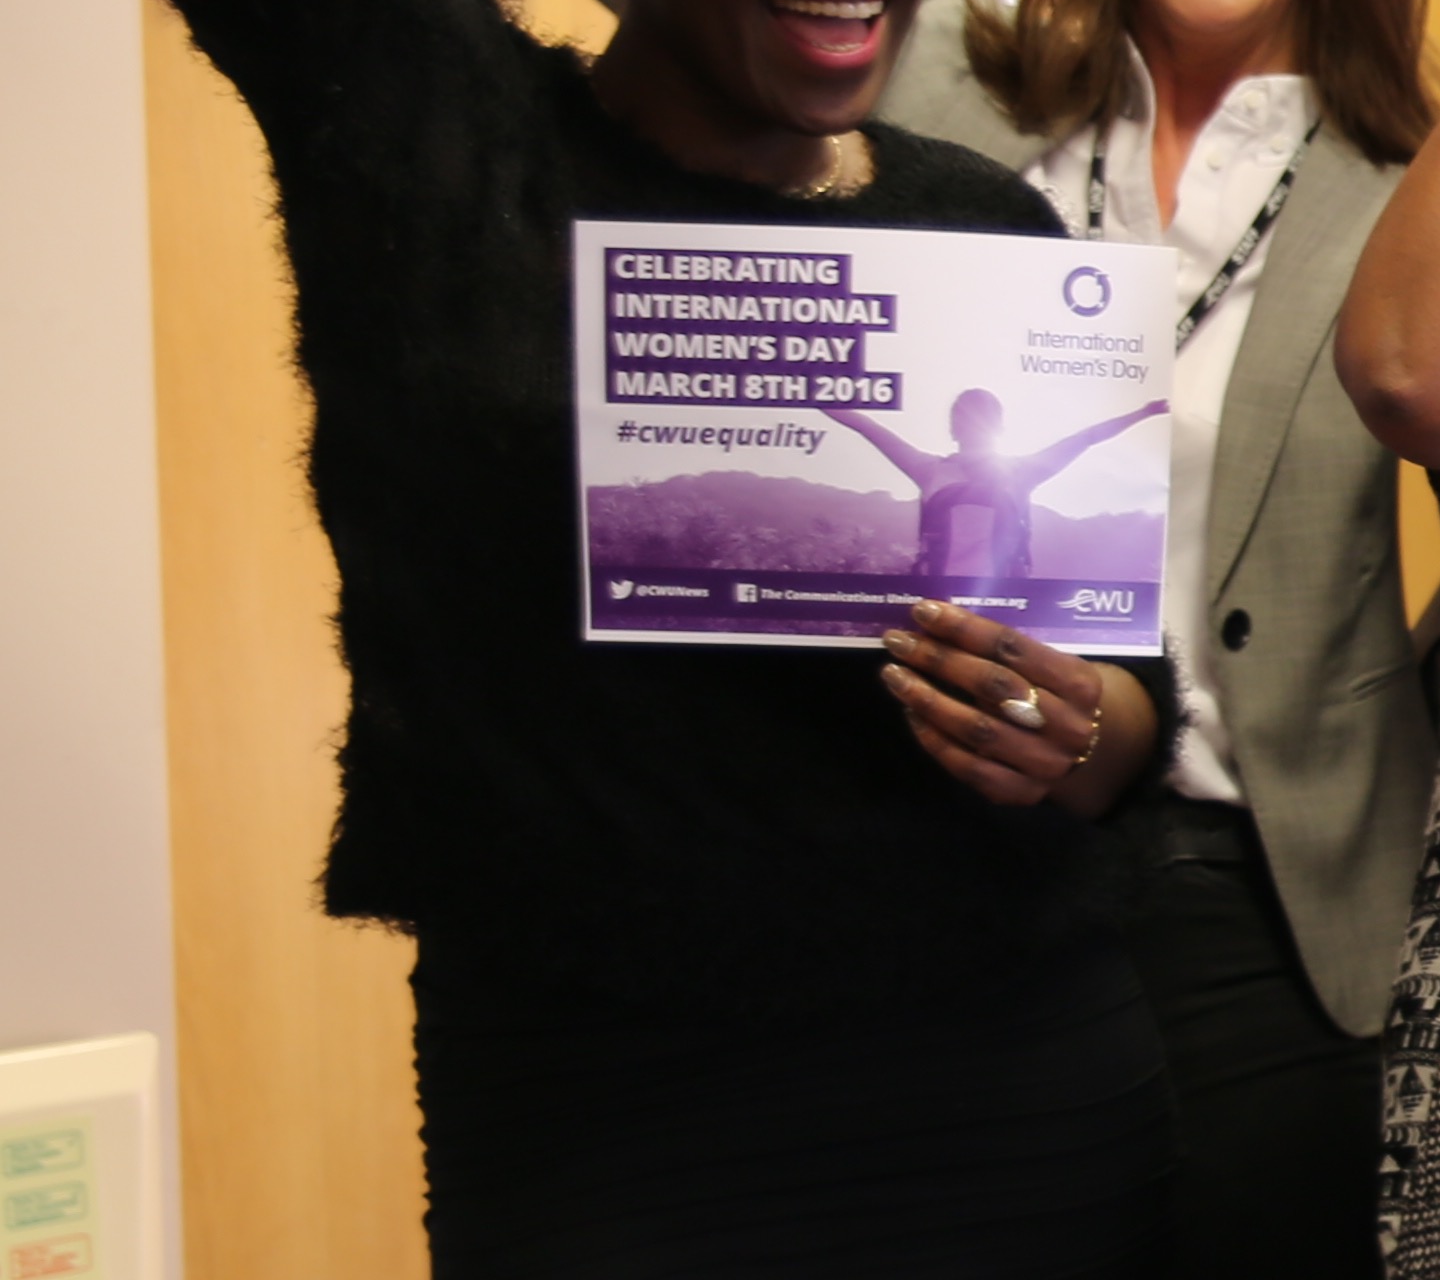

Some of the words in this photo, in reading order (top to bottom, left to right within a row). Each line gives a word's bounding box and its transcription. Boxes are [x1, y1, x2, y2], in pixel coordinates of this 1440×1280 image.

[615, 253, 840, 285] CELEBRATING
[615, 294, 889, 325] INTERNATIONAL
[785, 337, 855, 364] DAY
[1027, 329, 1144, 354] International
[1113, 358, 1149, 383] Day
[616, 372, 737, 400] MARCH
[744, 375, 807, 402] 8TH
[815, 377, 893, 403] 2016
[617, 422, 826, 454] #cwuequality
